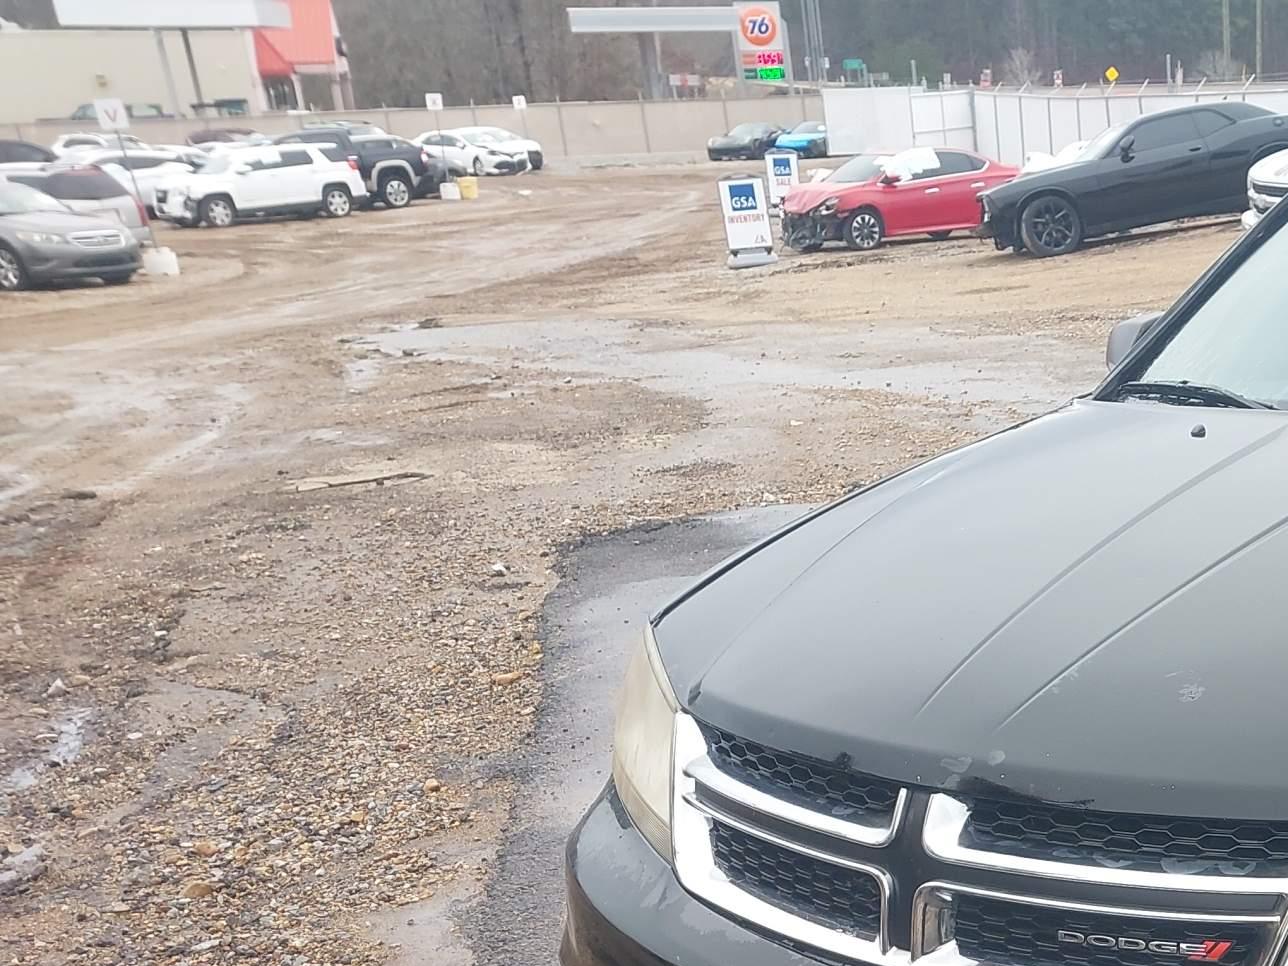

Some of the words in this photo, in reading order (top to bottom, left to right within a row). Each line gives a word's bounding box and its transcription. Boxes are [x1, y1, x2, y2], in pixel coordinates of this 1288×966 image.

[747, 16, 770, 35] 76
[774, 165, 791, 175] GSA
[732, 196, 756, 209] GSA
[727, 213, 765, 224] INVENTORY
[1057, 930, 1207, 956] DODGE
